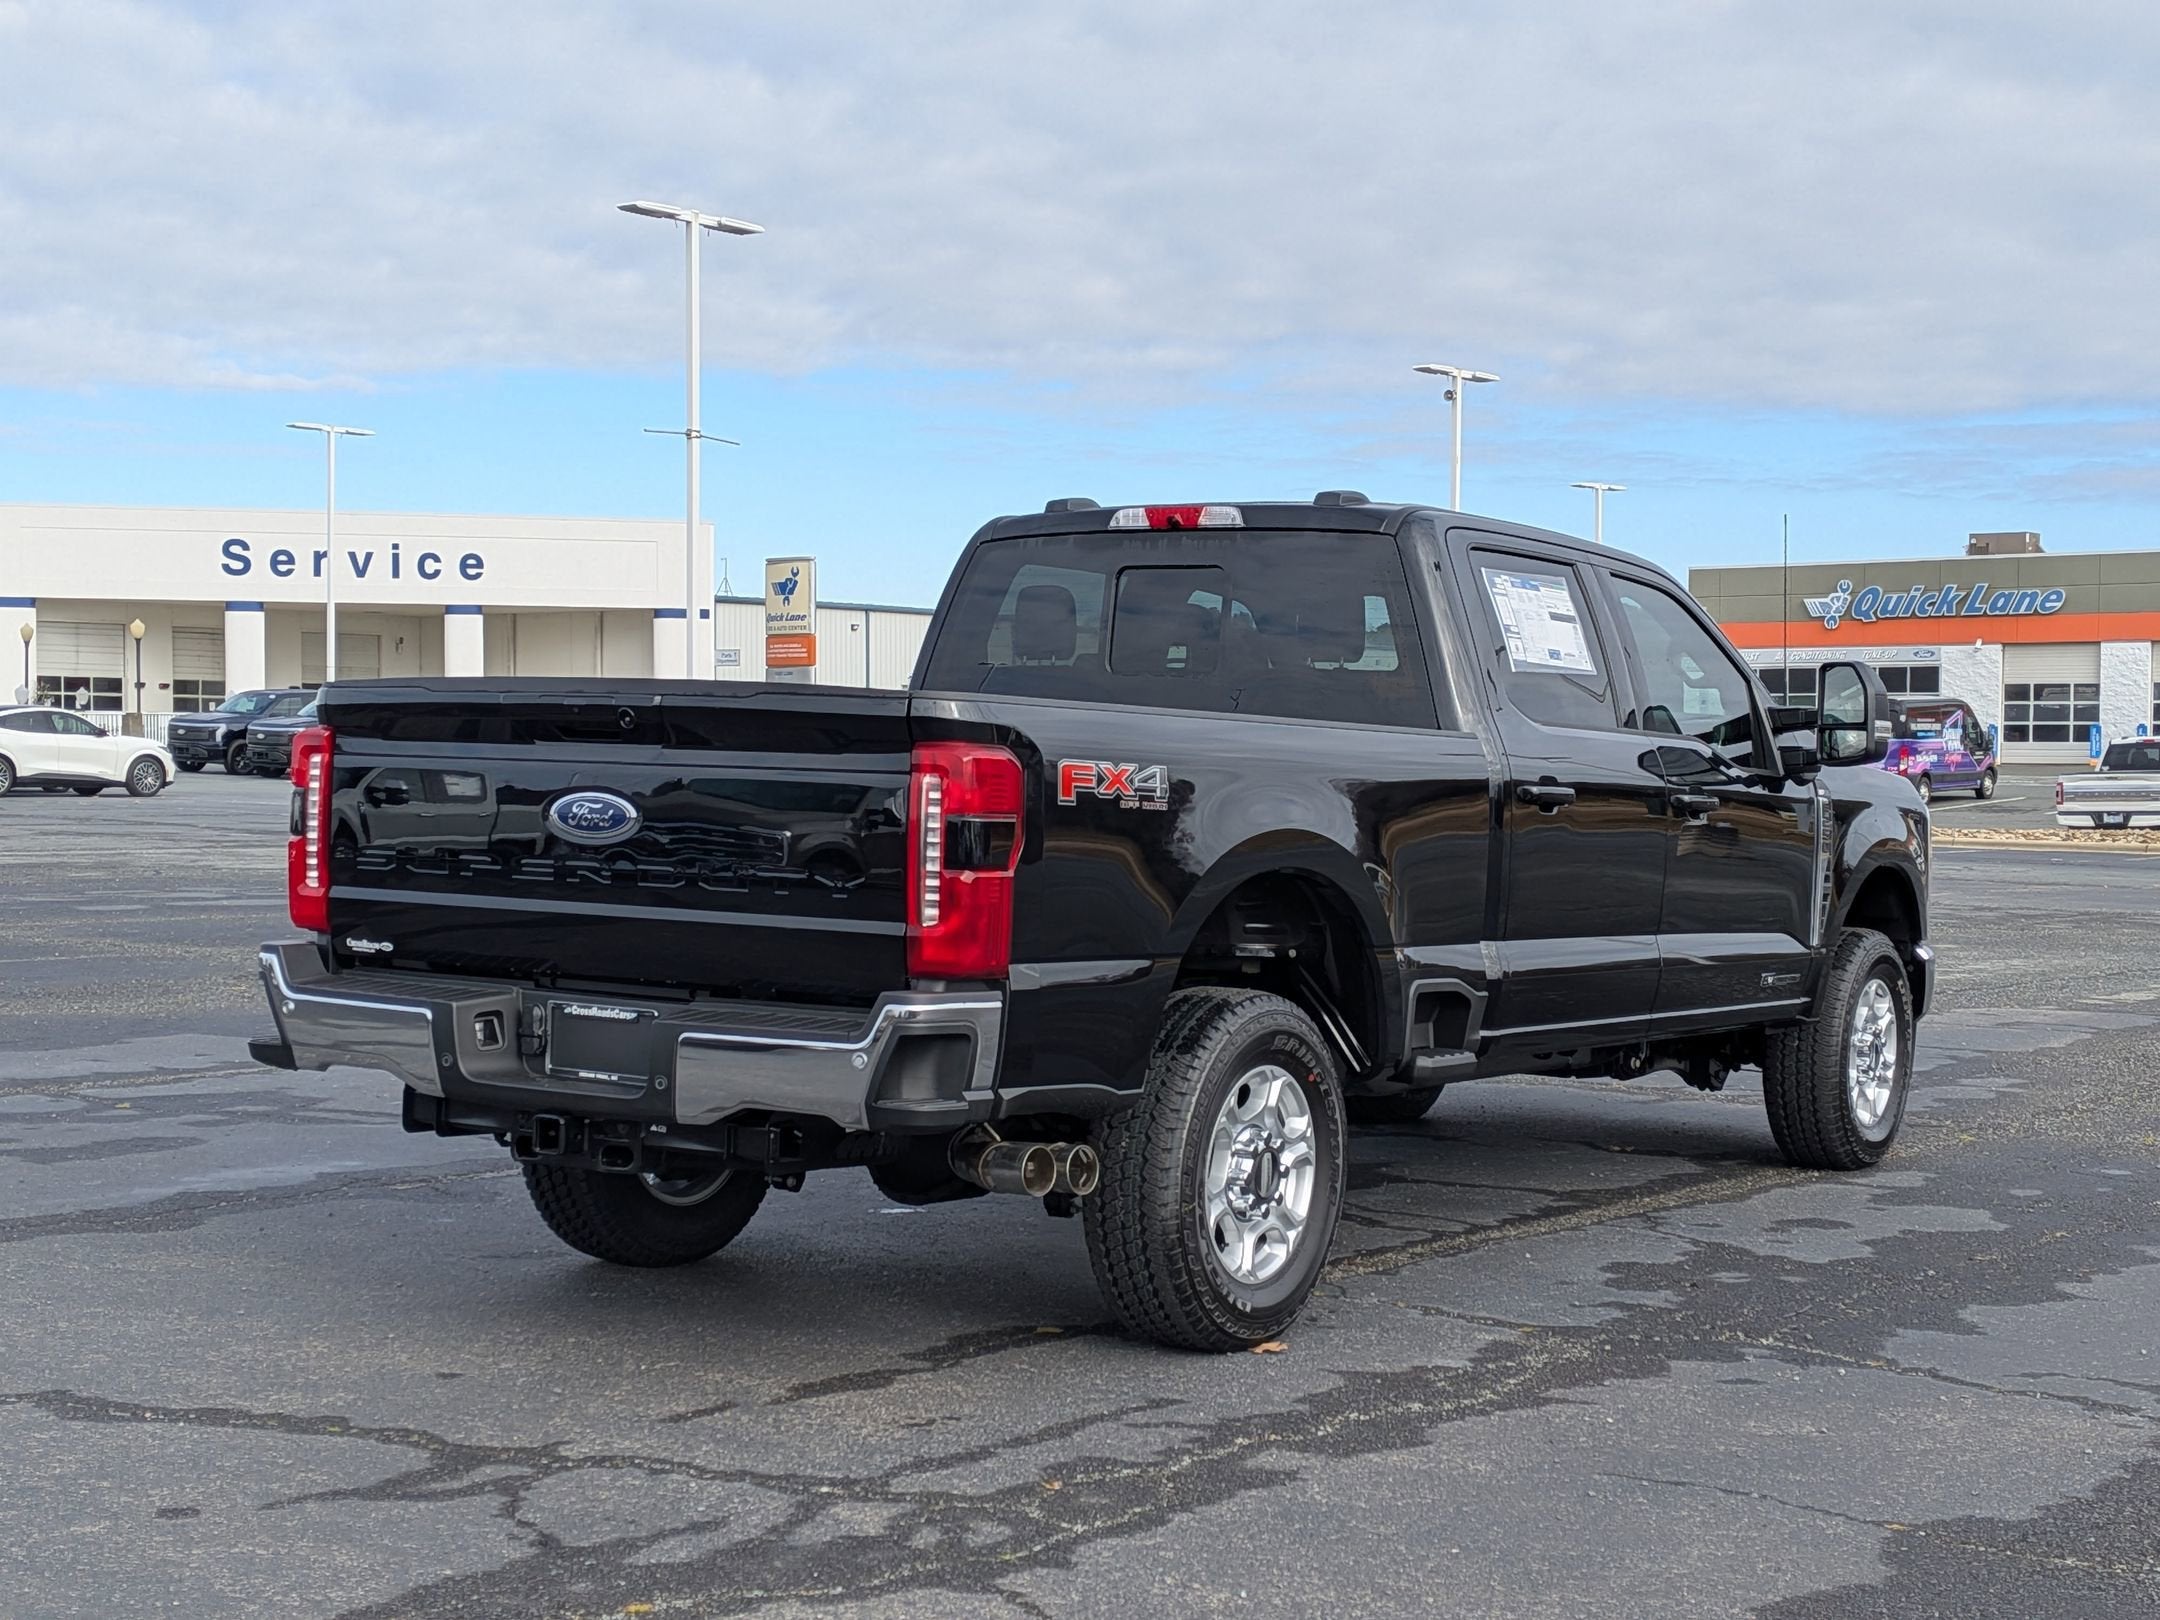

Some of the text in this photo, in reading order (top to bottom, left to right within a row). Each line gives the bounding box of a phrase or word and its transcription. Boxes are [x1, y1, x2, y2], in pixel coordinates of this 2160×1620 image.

[221, 538, 485, 581] Service
[785, 612, 807, 622] Lane
[1852, 583, 2066, 622] Quick Lane
[1791, 649, 1847, 661] CONDITIONING
[1057, 758, 1170, 806] FX4
[567, 801, 615, 828] Ford
[356, 849, 867, 898] SUPER DUTY
